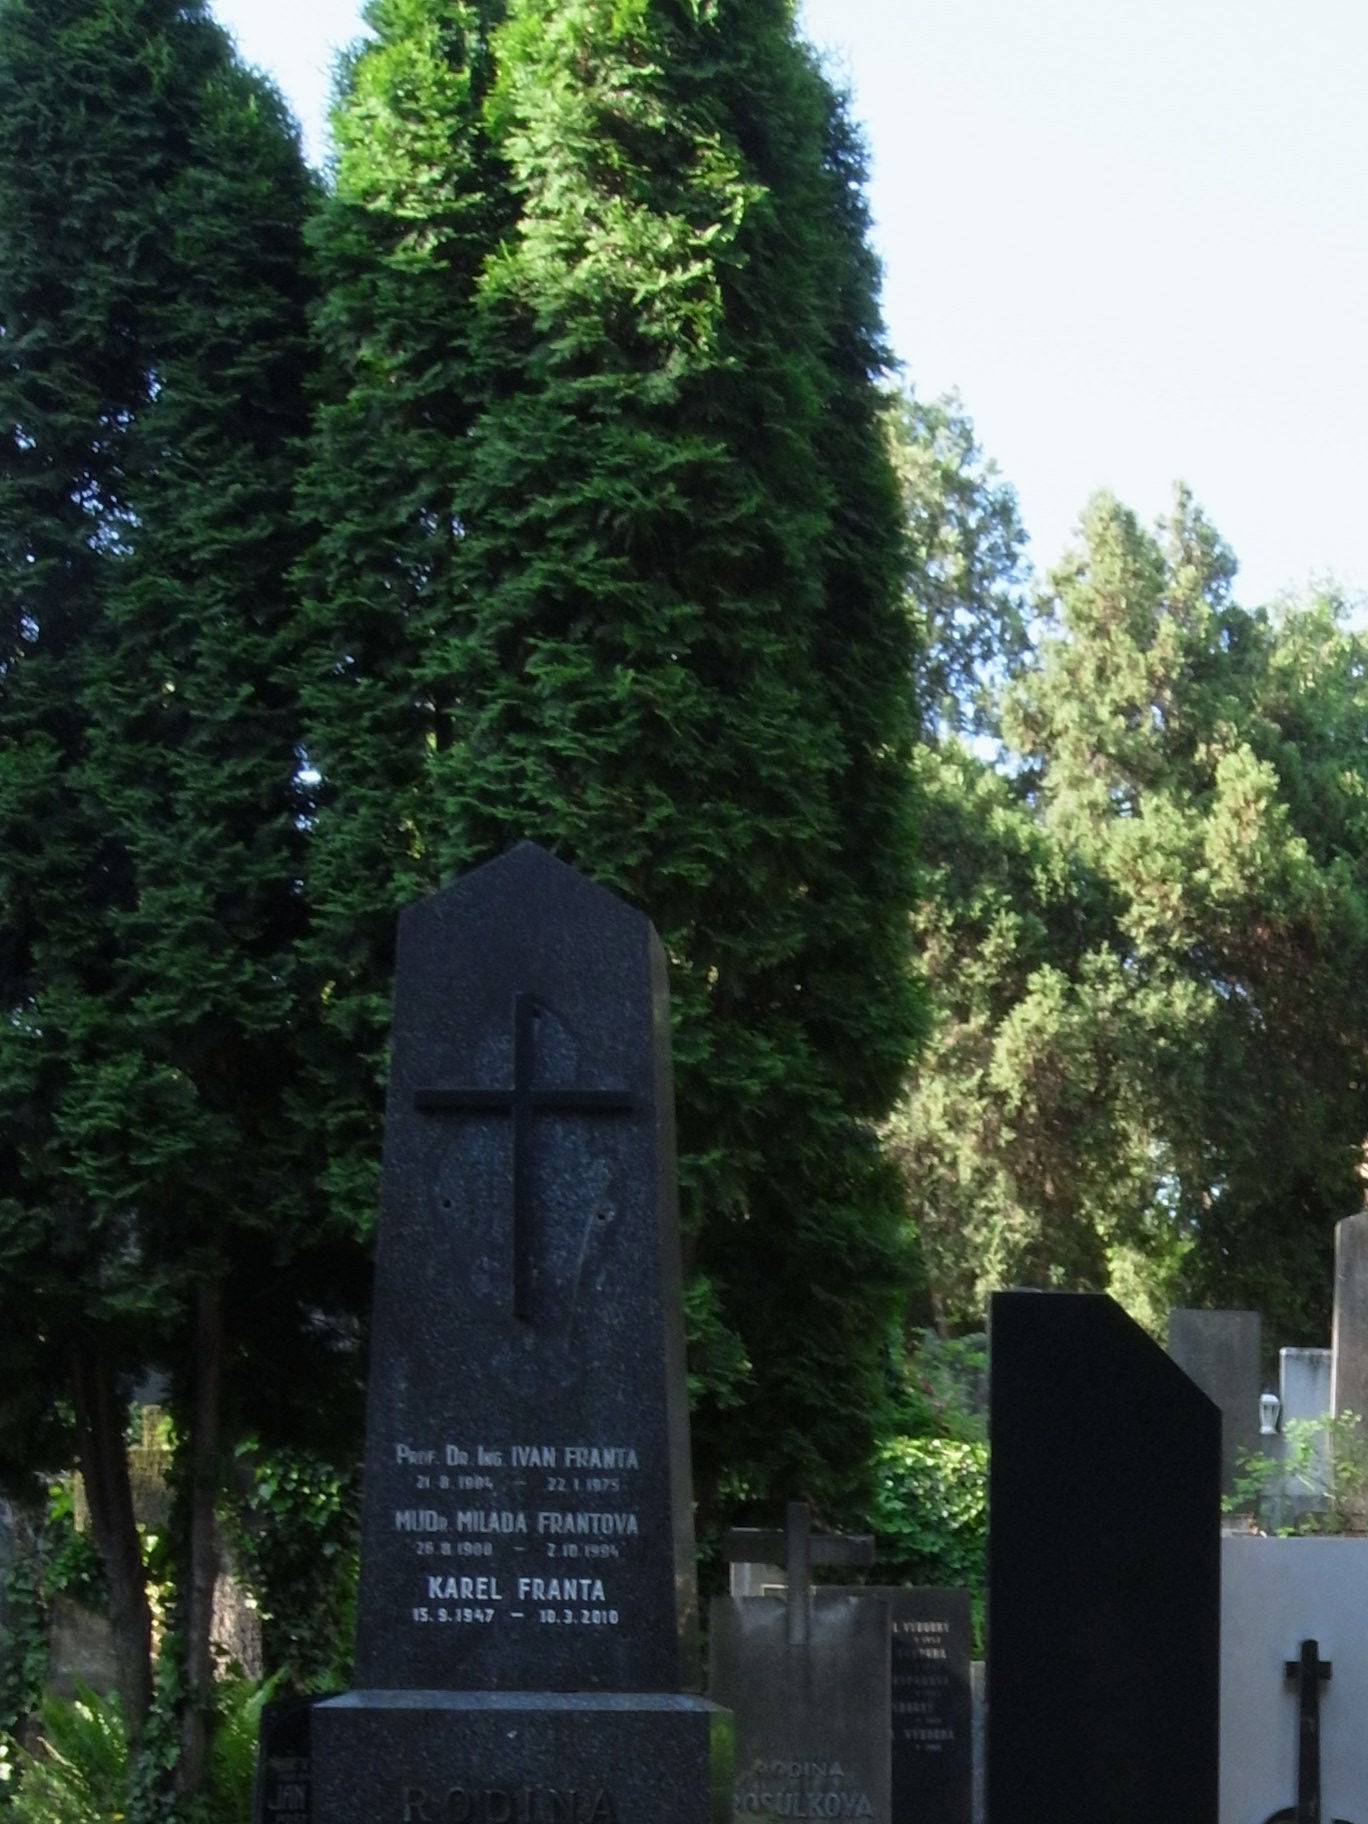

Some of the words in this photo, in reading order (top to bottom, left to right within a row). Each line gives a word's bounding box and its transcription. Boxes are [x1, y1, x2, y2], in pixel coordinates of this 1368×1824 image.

[510, 1446, 557, 1469] IVAN
[564, 1447, 640, 1473] FRANTA
[456, 1511, 528, 1535] MILADA
[427, 1576, 503, 1601] KAREL
[517, 1577, 607, 1602] FRANTA
